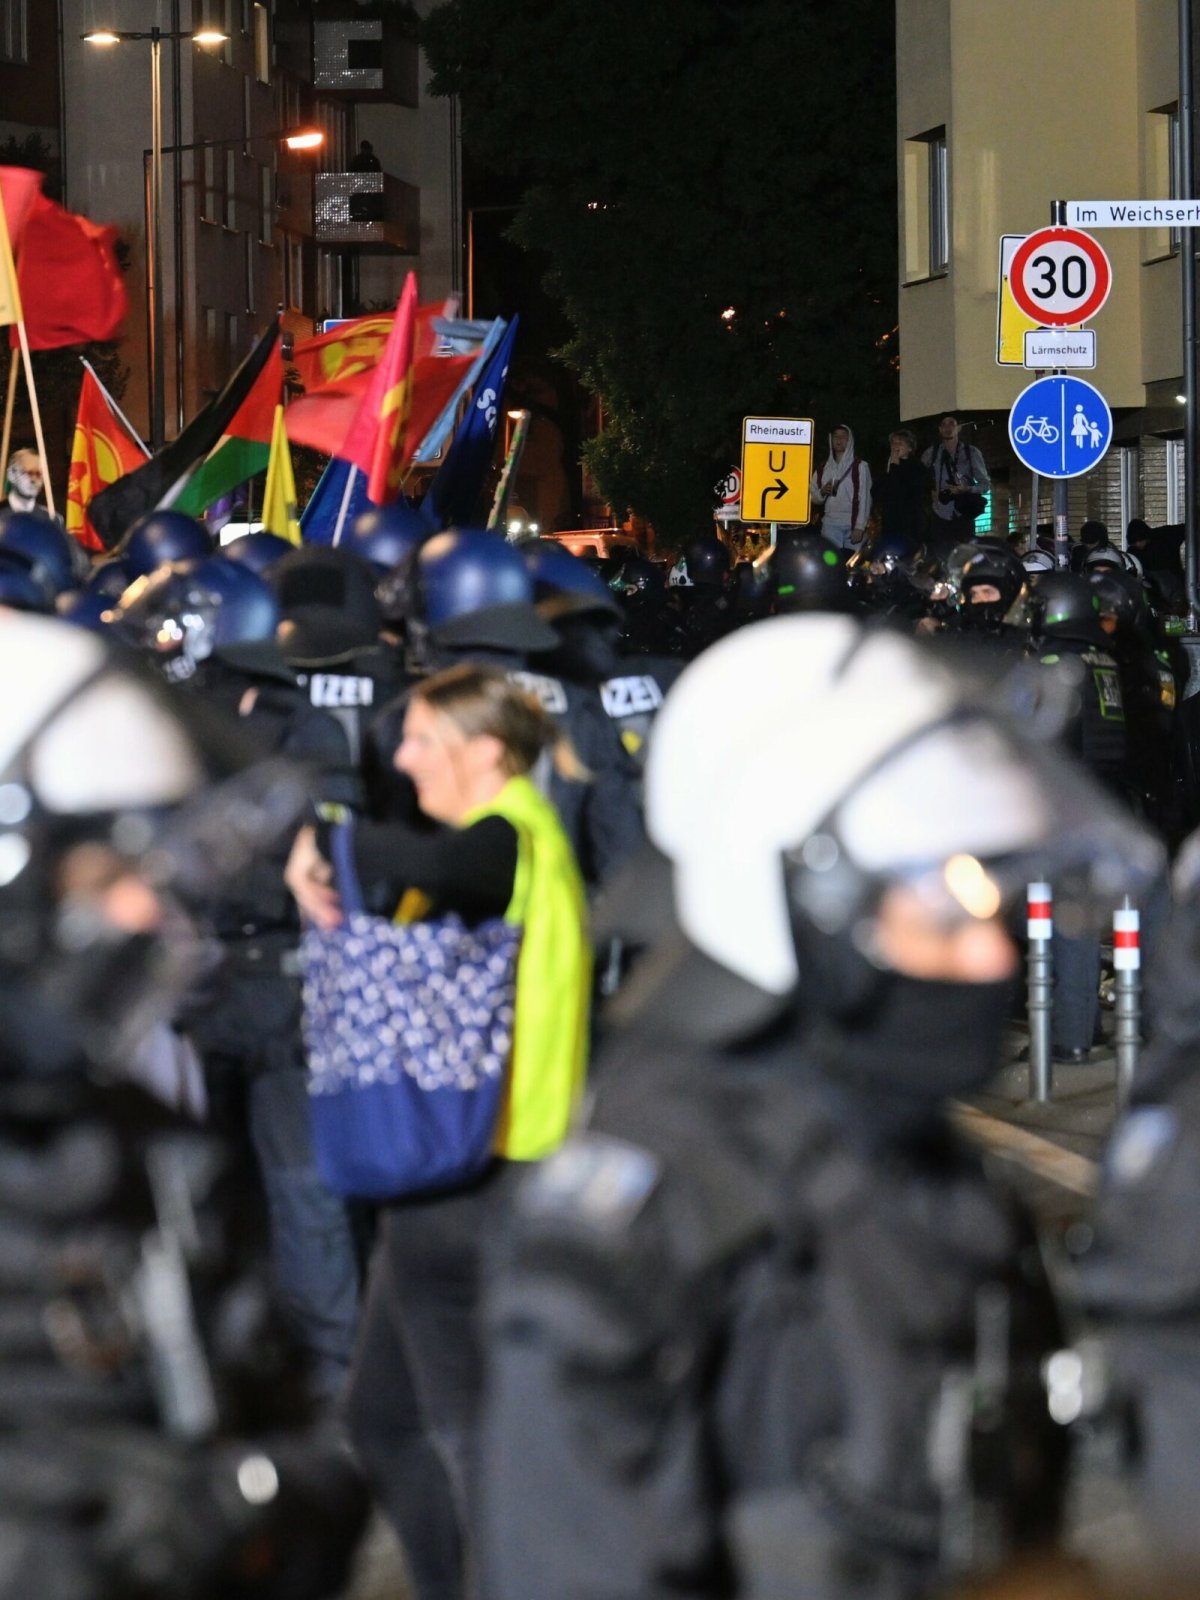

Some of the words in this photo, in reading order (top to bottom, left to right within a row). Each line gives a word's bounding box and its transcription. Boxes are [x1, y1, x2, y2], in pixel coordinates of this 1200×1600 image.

[1076, 207, 1098, 222] Im
[1031, 255, 1087, 298] 30
[1031, 345, 1088, 355] Lärmschutz
[750, 424, 807, 436] Rheinaustr.
[769, 450, 786, 472] U
